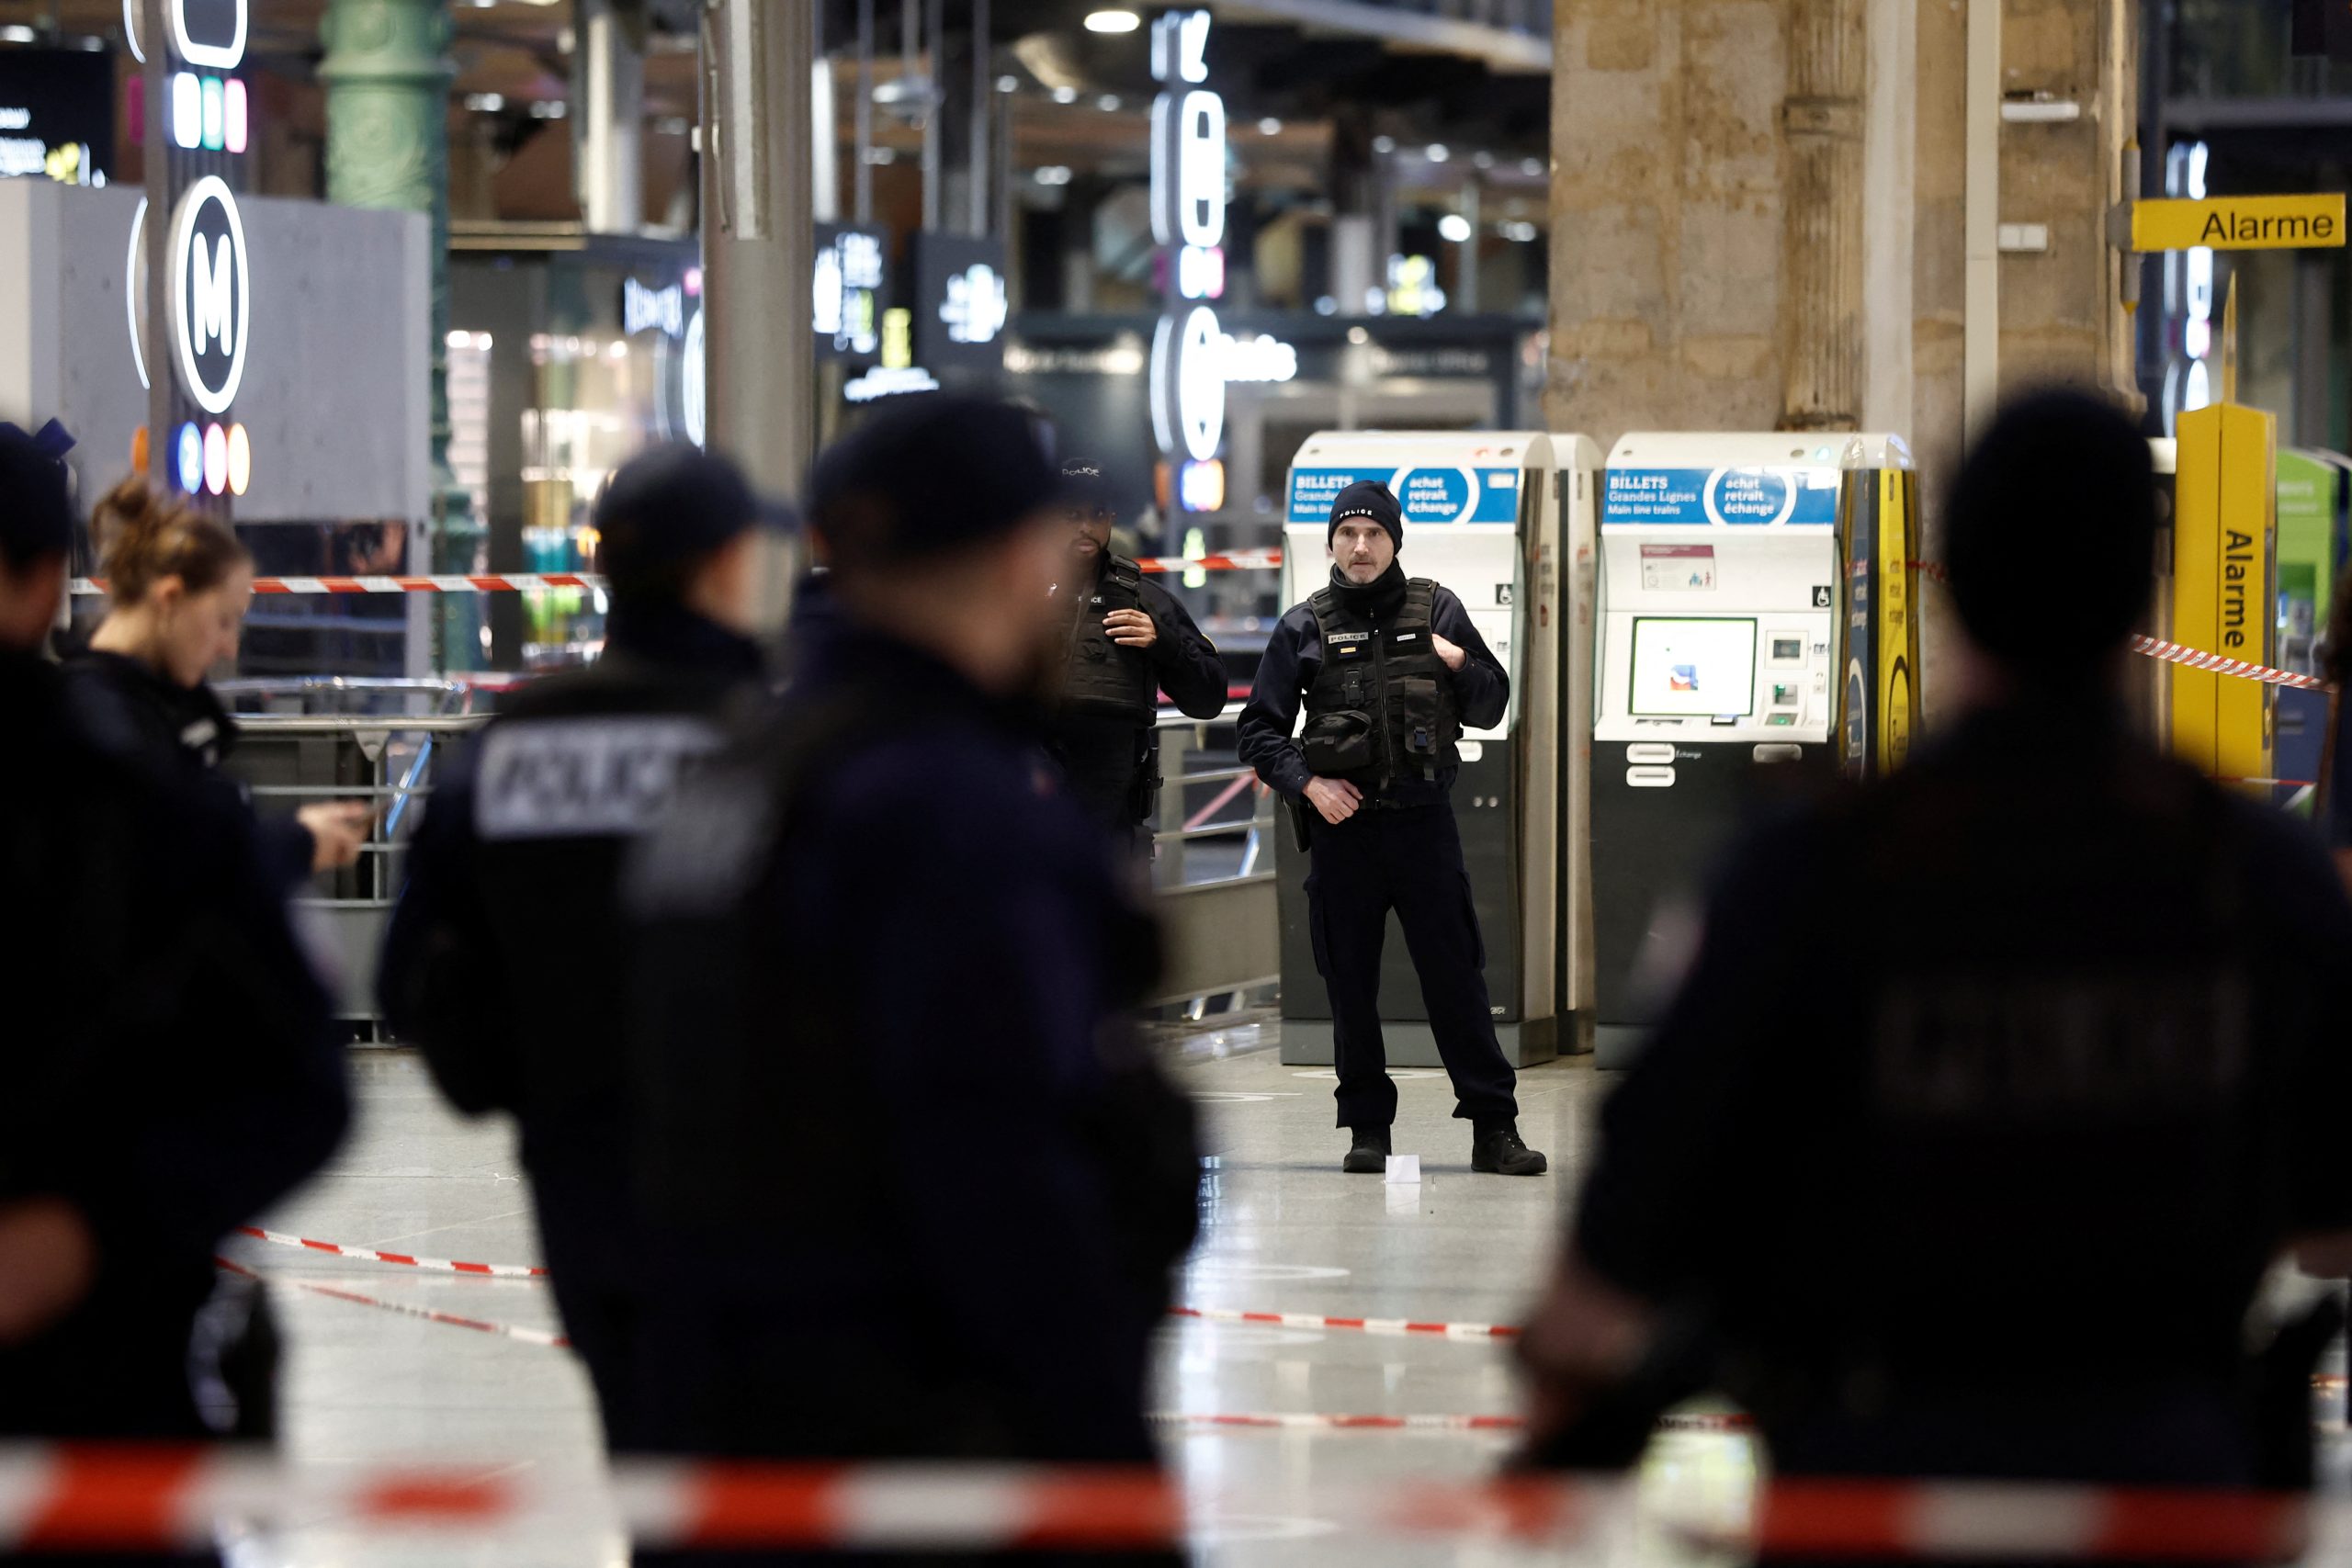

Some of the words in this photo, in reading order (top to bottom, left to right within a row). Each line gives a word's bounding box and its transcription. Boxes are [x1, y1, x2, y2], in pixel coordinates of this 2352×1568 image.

[2201, 212, 2335, 242] Alarme
[193, 231, 232, 357] M
[1409, 476, 1444, 489] achat
[1610, 476, 1668, 490] BILLETS
[1725, 478, 1759, 489] achat
[1408, 490, 1448, 501] retrait
[1609, 490, 1657, 502] Grandes
[1659, 490, 1697, 504] Lignes
[1724, 490, 1764, 502] retrait
[1294, 503, 1318, 513] Main
[1340, 509, 1373, 519] POLICE
[1408, 502, 1458, 515] échange
[1608, 504, 1632, 514] Main
[1634, 504, 1652, 514] line
[1653, 504, 1681, 514] trains
[1724, 502, 1775, 516] échange
[2225, 530, 2253, 649] Alarme
[1330, 634, 1365, 642] POLICE
